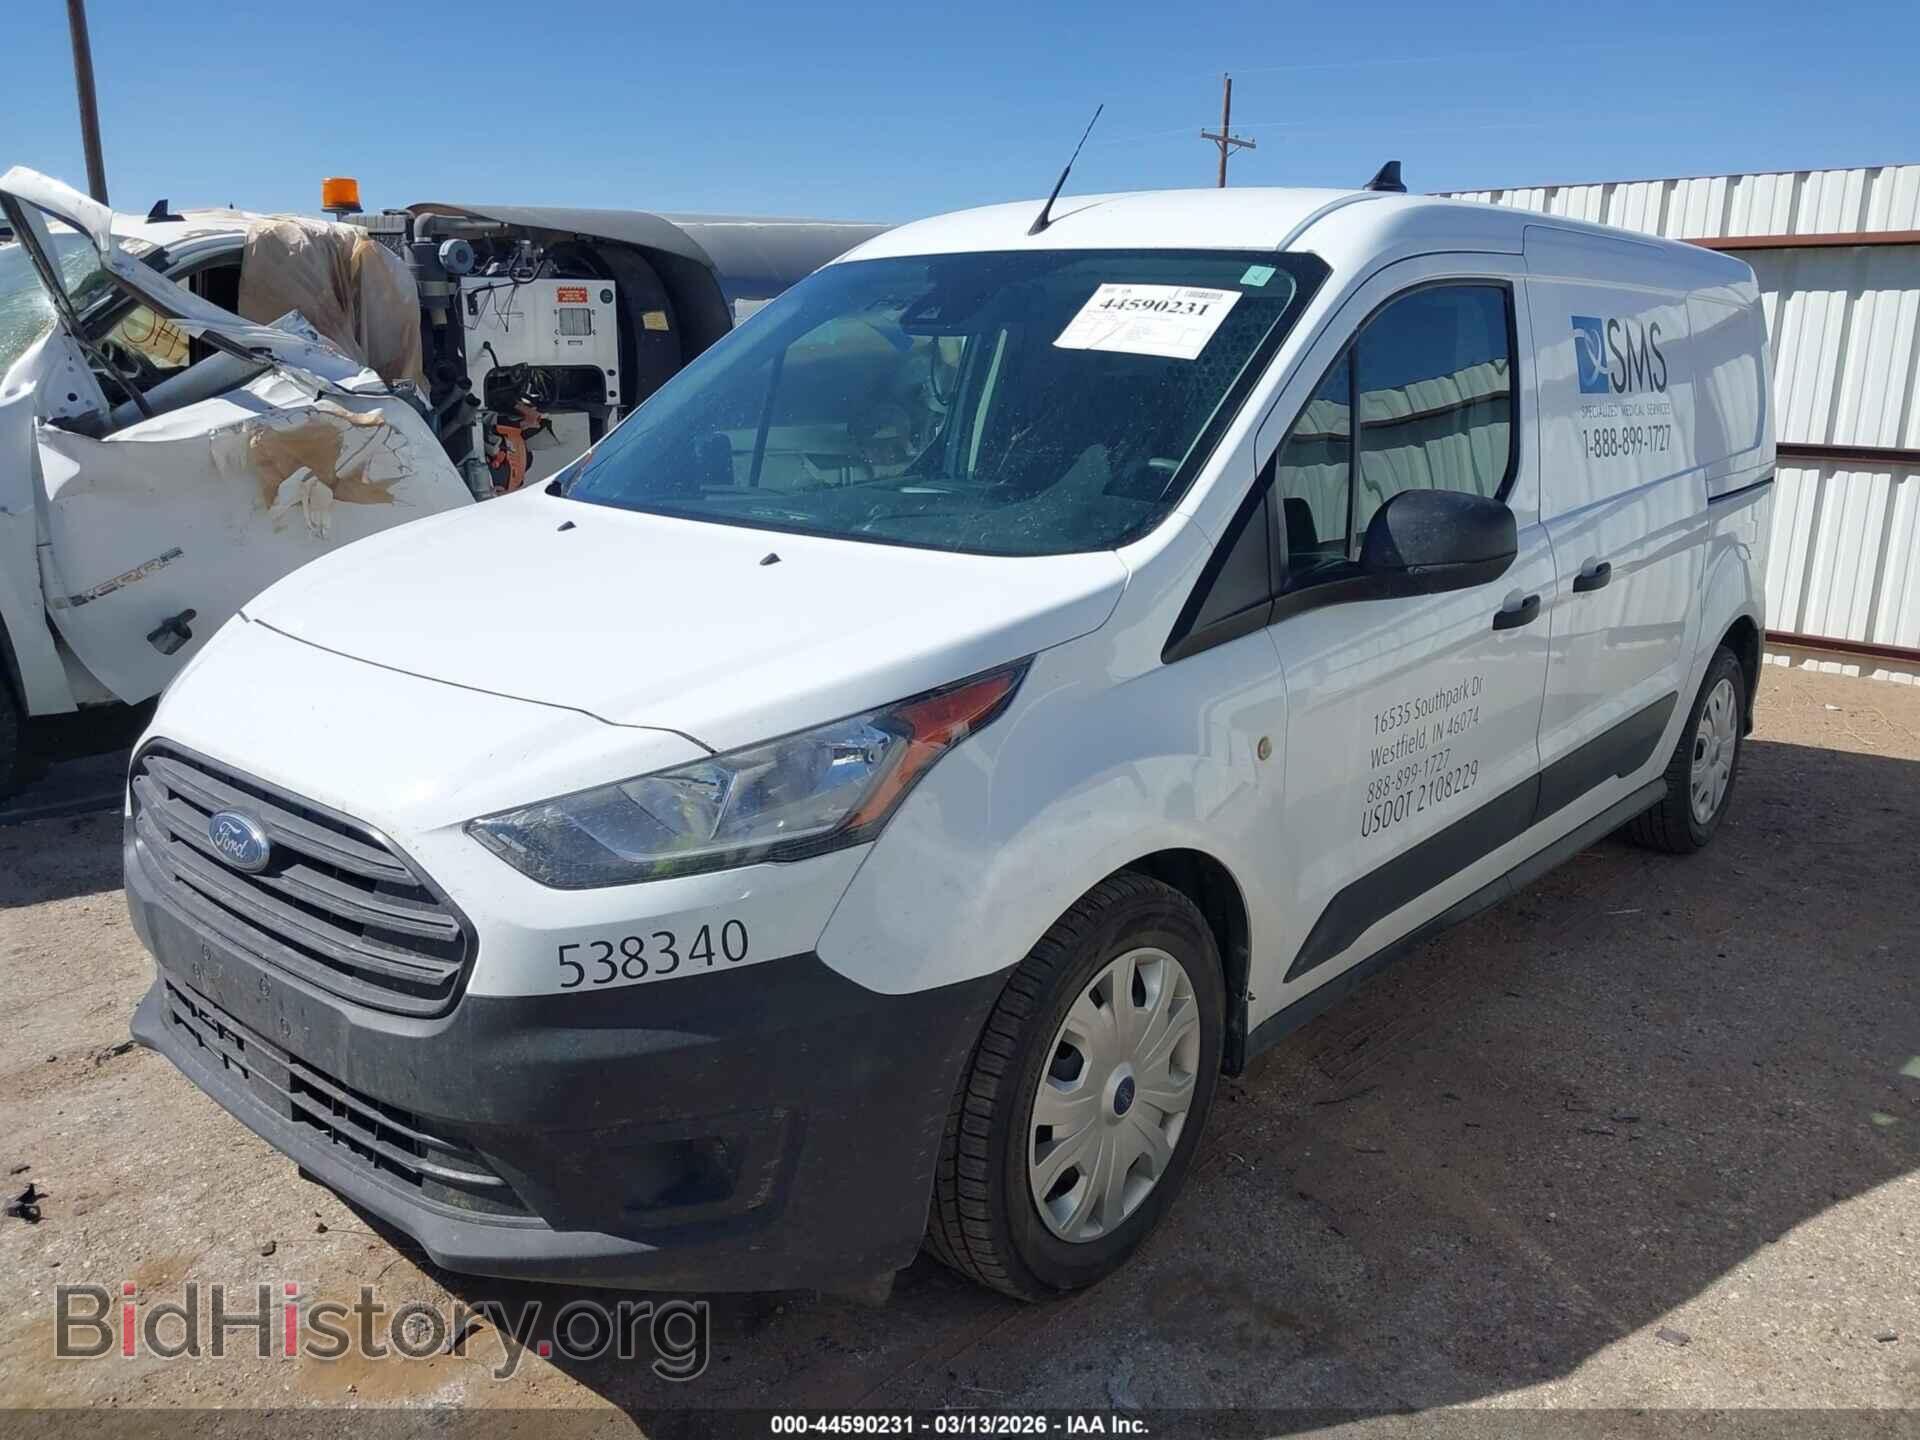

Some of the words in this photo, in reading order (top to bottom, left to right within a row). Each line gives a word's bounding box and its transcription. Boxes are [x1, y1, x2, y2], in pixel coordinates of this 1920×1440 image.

[1099, 297, 1210, 317] 44590231
[1607, 318, 1667, 394] SMS
[1583, 424, 1671, 458] 1-888-899-1727
[1374, 702, 1411, 735] 16535
[1414, 679, 1469, 720] Southpark
[1472, 676, 1484, 696] Dr
[1370, 725, 1428, 768] Westfield,
[1432, 720, 1444, 744] IN
[1447, 706, 1479, 736] 46074
[1361, 790, 1413, 837] USDOT
[1417, 760, 1479, 812] 2108229
[1367, 748, 1451, 803] 888-899-1727
[215, 821, 249, 858] Ford
[558, 919, 749, 988] 538340
